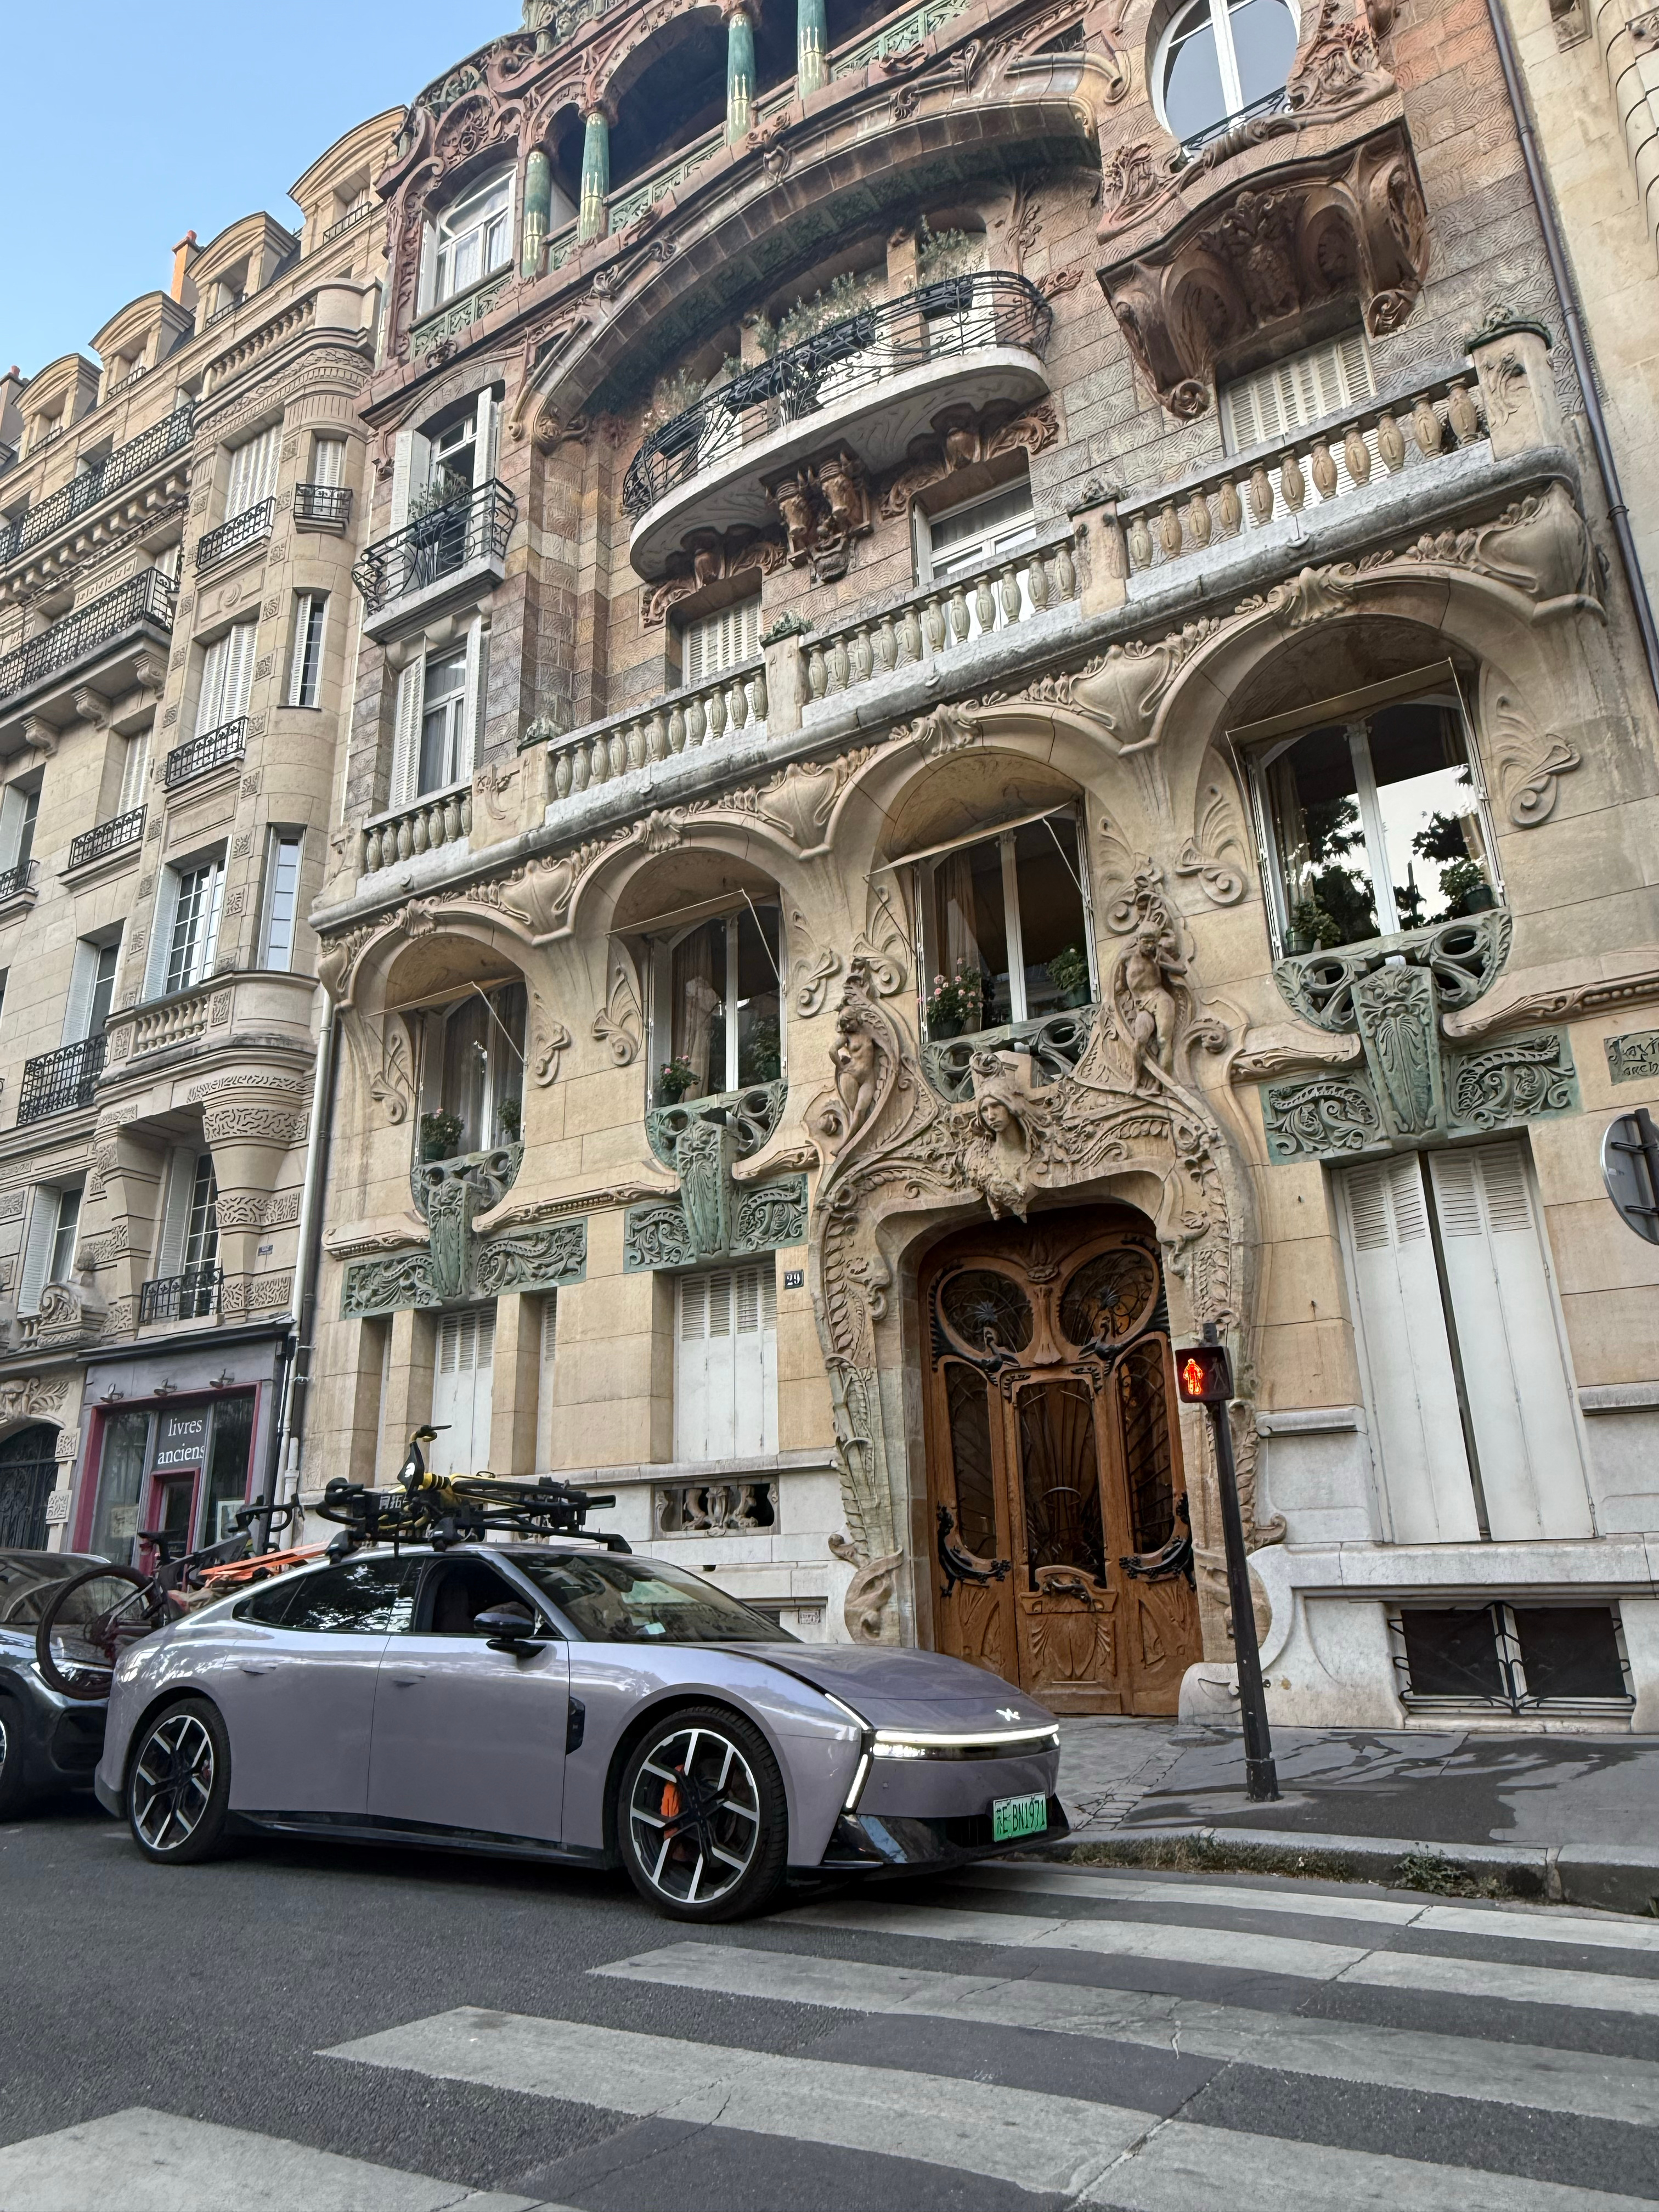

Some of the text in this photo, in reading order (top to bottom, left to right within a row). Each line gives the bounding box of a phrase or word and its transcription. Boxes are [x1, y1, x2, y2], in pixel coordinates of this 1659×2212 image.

[786, 1273, 800, 1286] 29
[168, 1418, 202, 1436] livres
[157, 1443, 206, 1465] anciens
